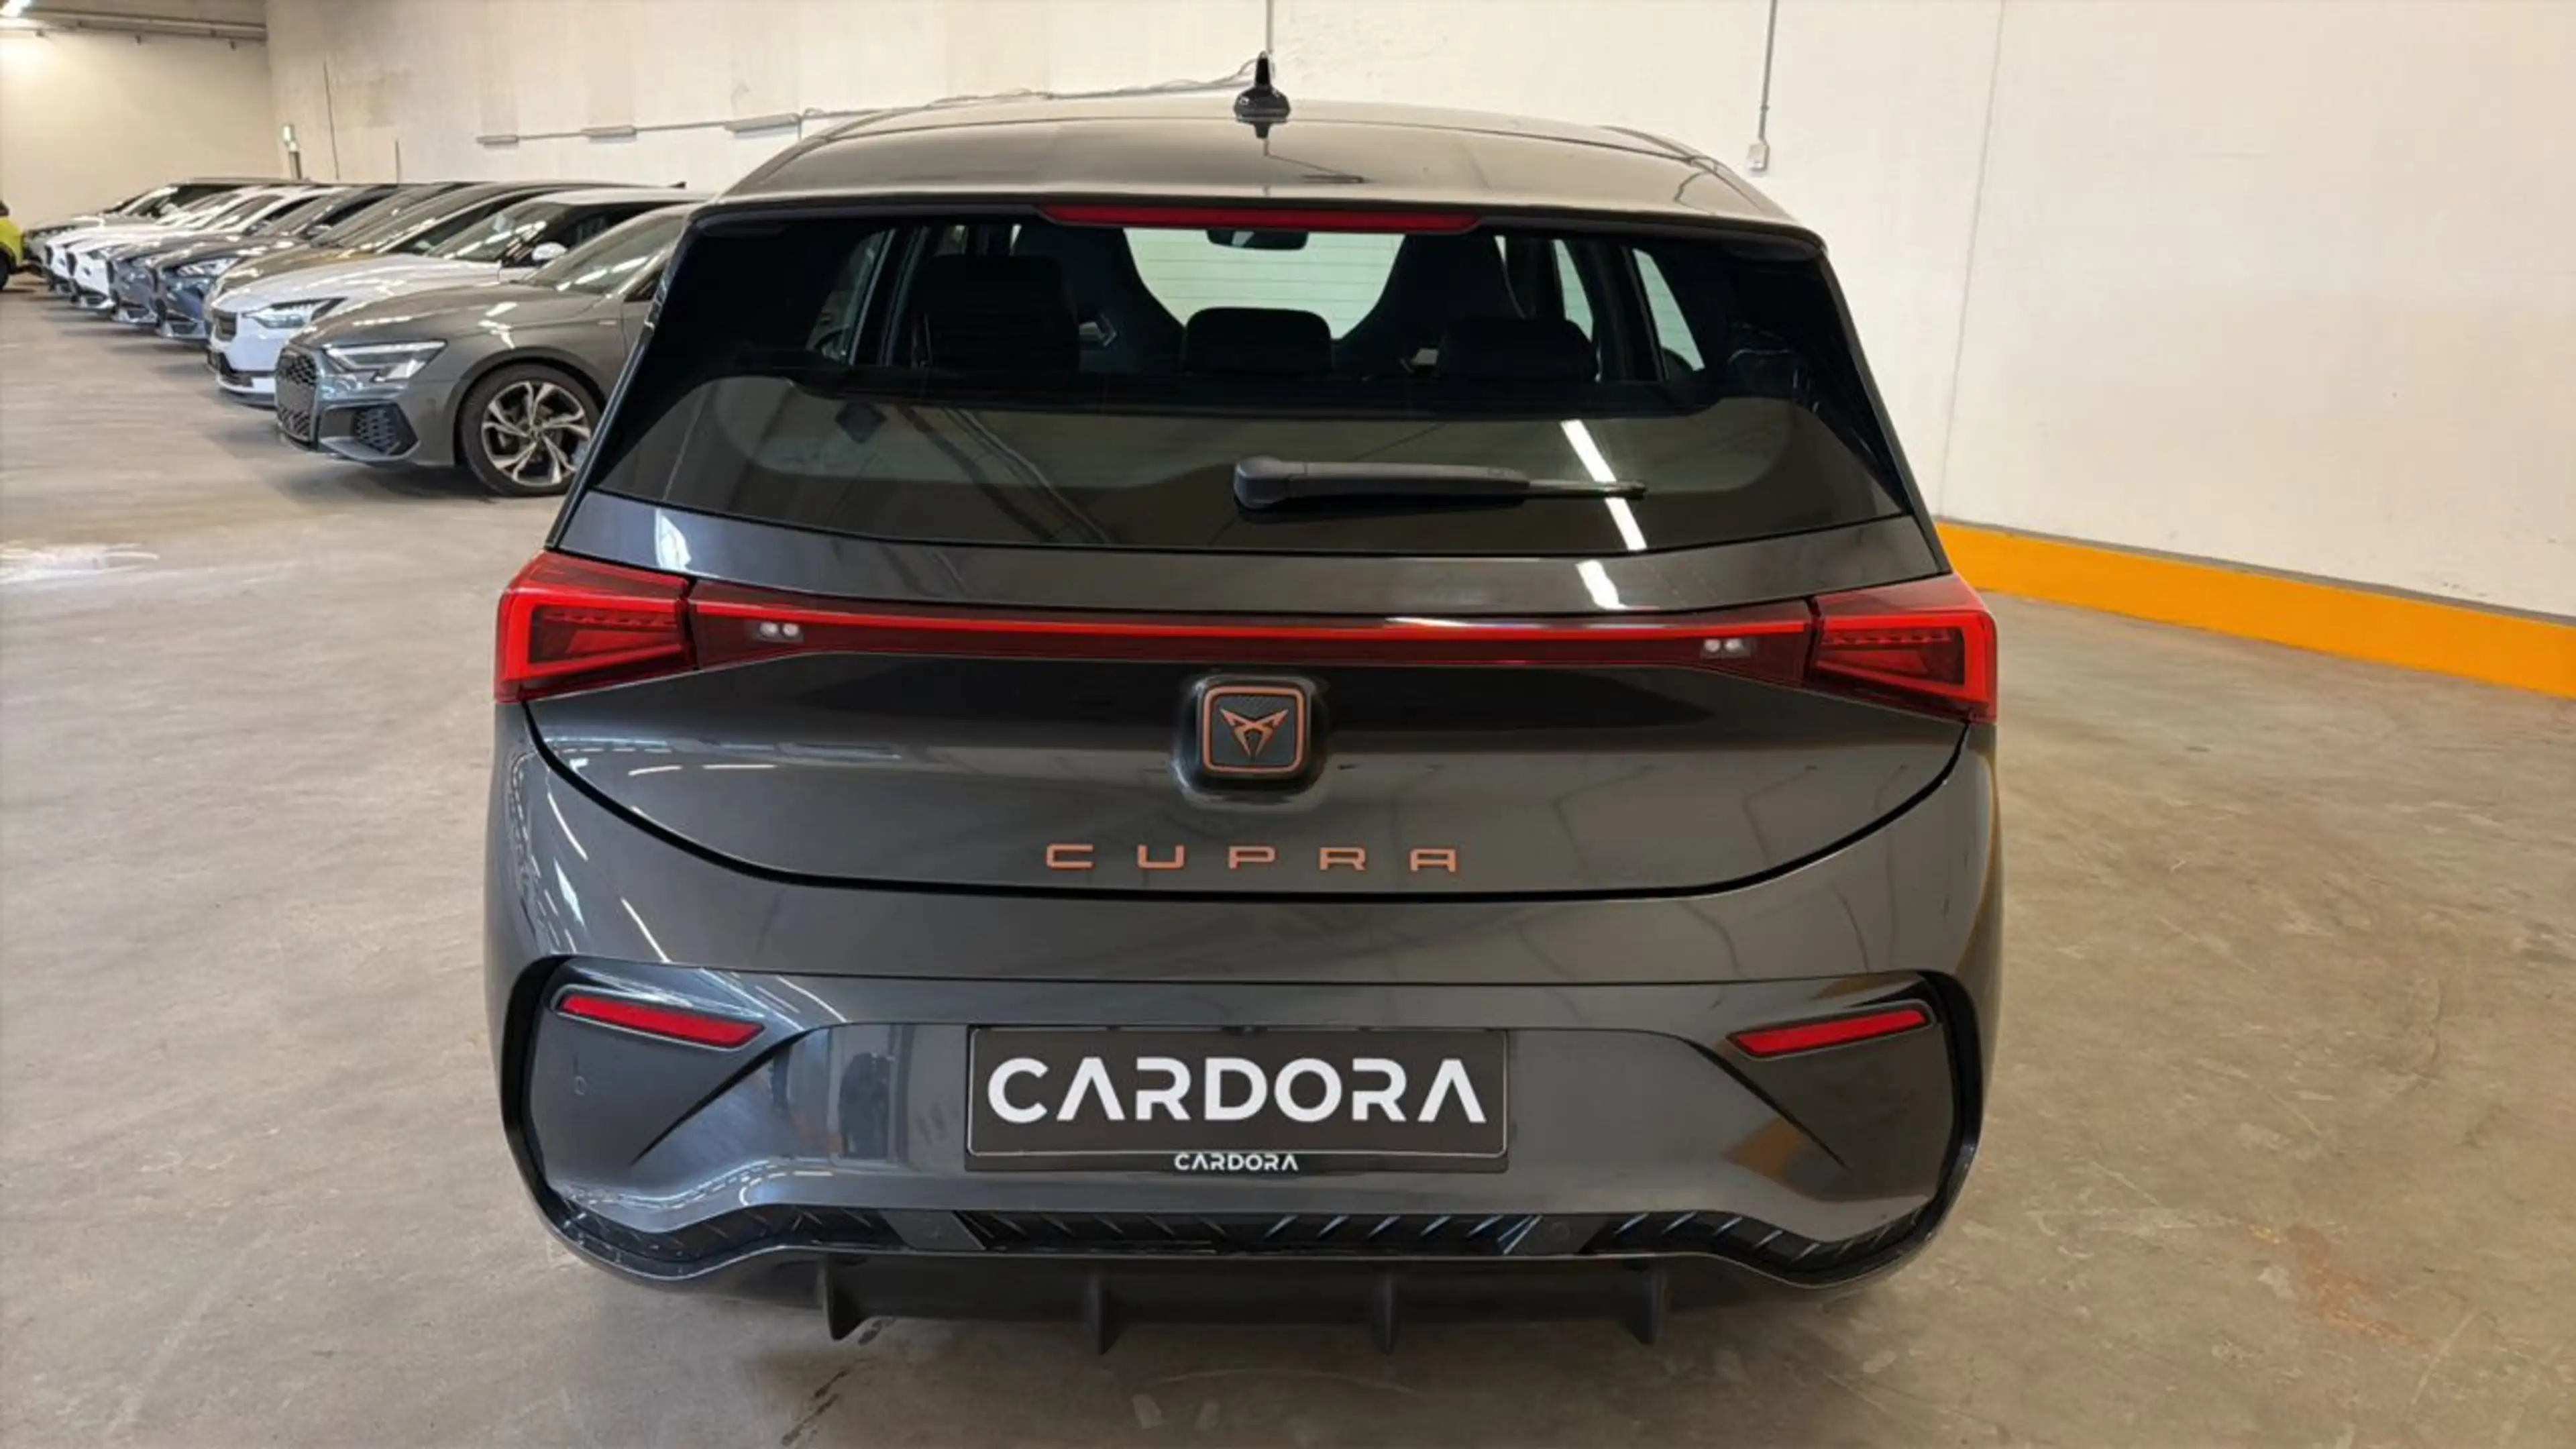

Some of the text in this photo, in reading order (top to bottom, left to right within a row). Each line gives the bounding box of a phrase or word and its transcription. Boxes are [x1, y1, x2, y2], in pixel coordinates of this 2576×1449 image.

[1046, 844, 1458, 872] CUPRA
[987, 1057, 1487, 1123] CARDORA
[1174, 1152, 1299, 1172] CARDORA
